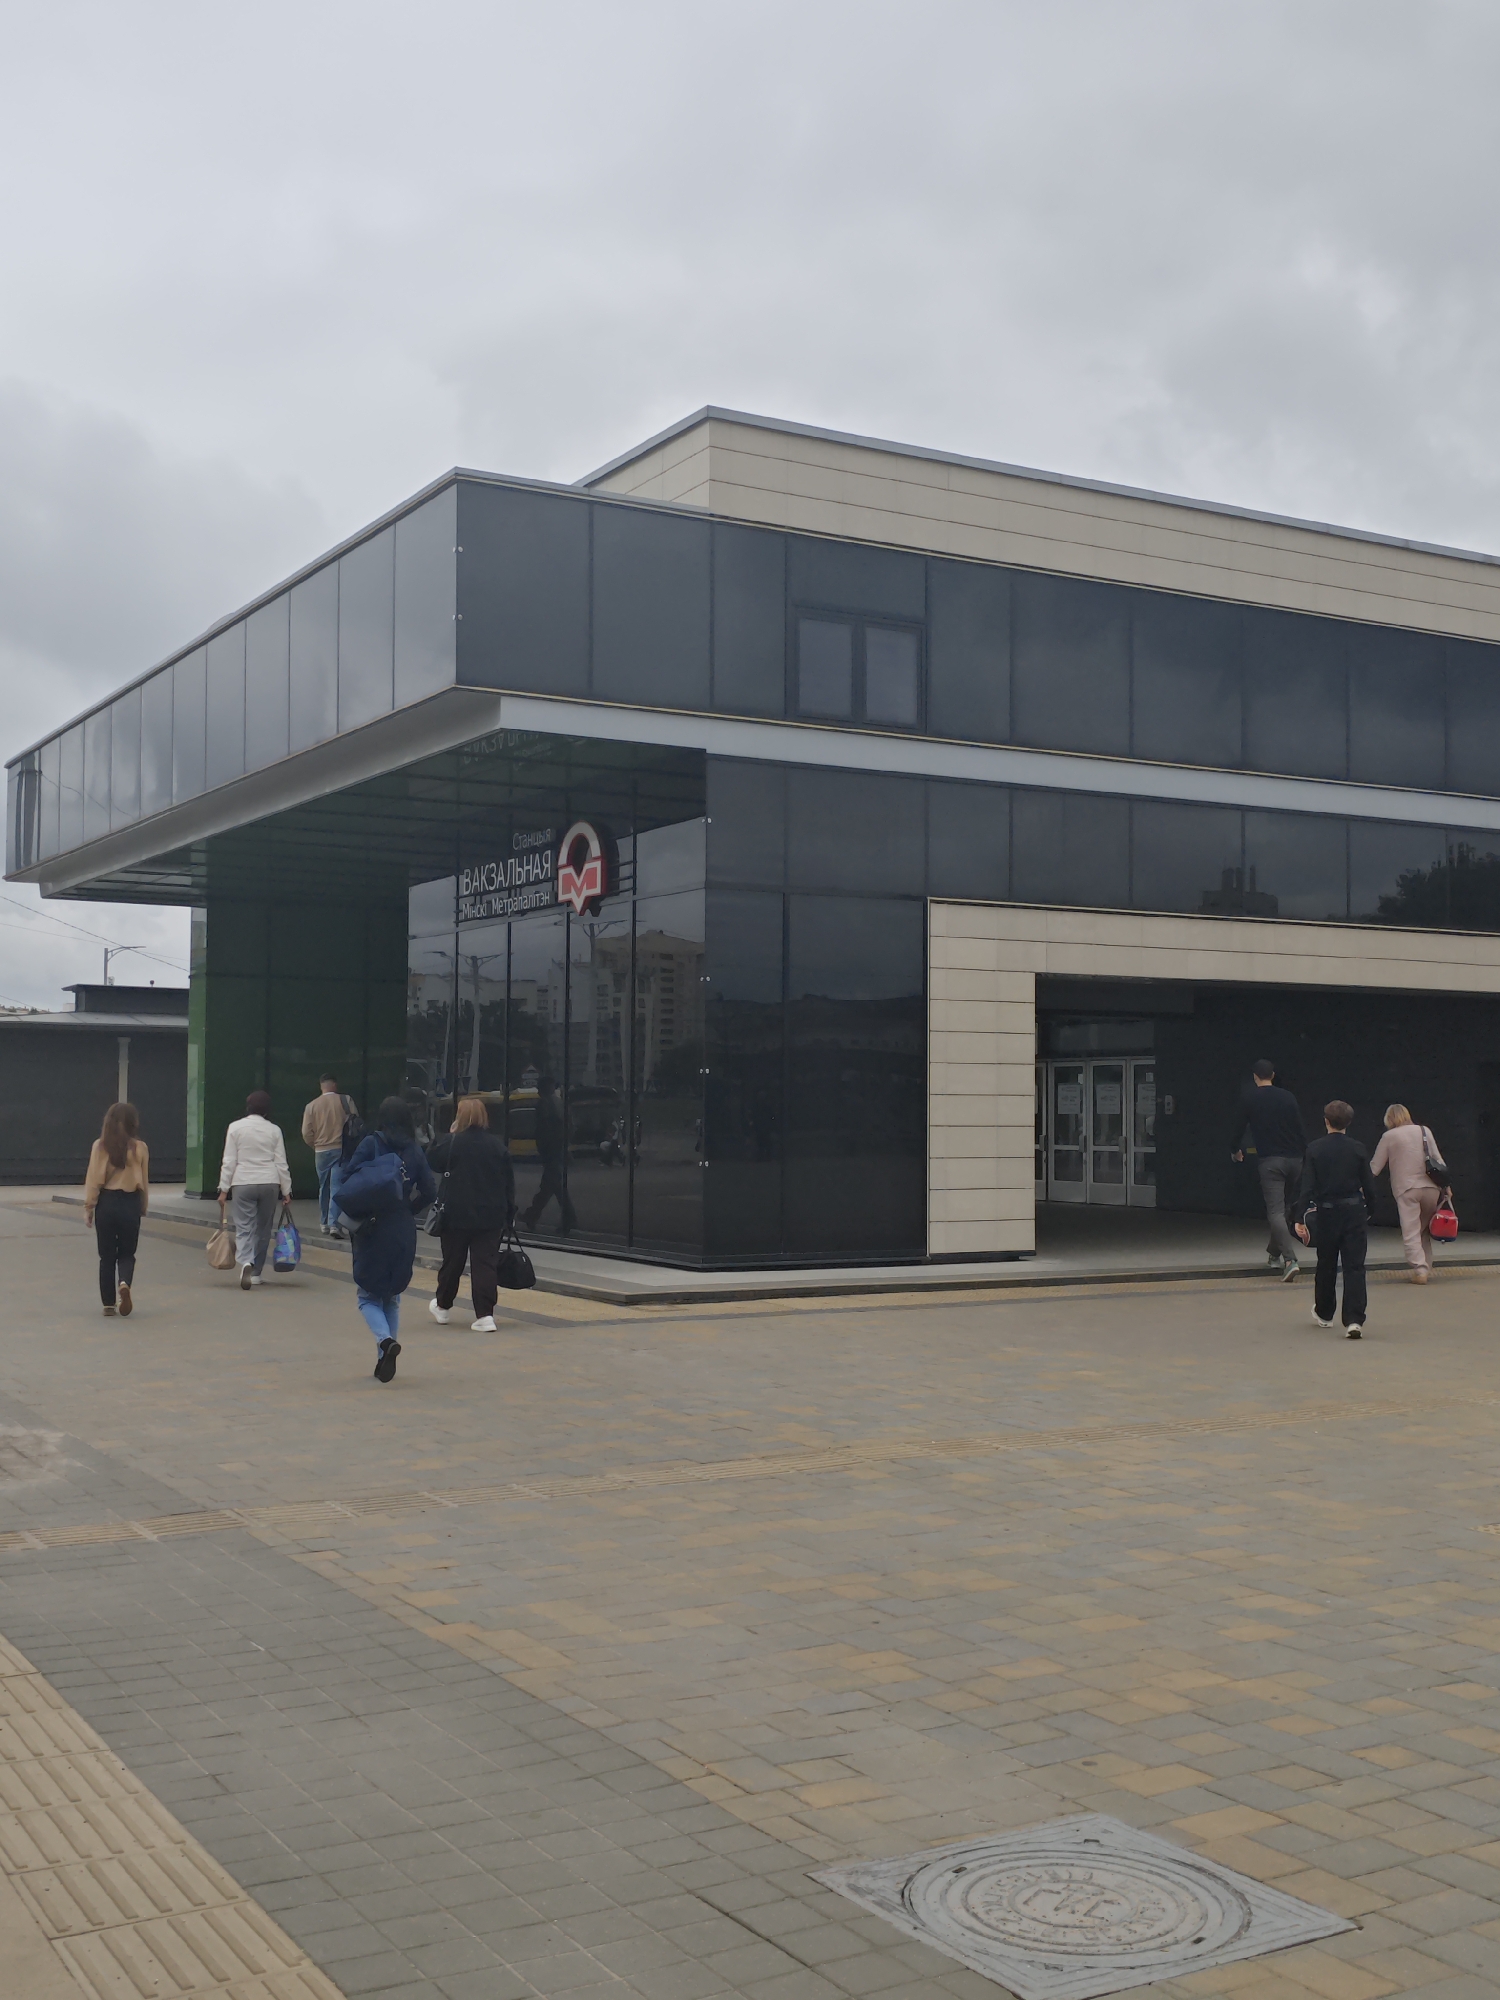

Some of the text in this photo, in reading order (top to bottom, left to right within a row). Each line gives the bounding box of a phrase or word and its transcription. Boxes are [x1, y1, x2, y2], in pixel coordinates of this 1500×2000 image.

[512, 828, 551, 850] Станцыя
[463, 850, 551, 895] ВАКЗАЛЬНАЯ
[462, 891, 550, 920] Мінскі Метрапалітэн
